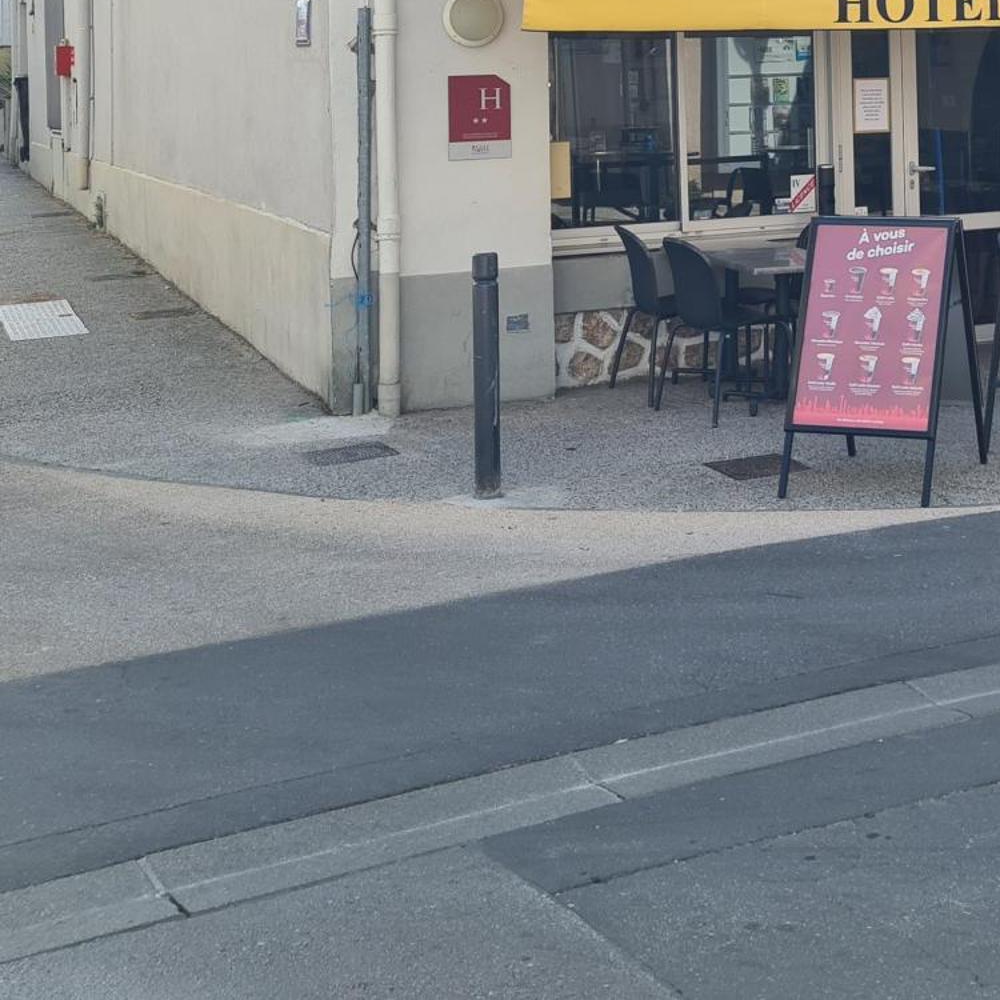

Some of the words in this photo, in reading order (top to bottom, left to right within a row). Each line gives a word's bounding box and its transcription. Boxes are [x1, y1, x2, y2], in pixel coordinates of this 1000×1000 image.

[478, 87, 502, 110] H
[859, 228, 870, 245] À
[873, 229, 906, 242] vous
[846, 246, 865, 261] de
[867, 239, 916, 258] choisir
